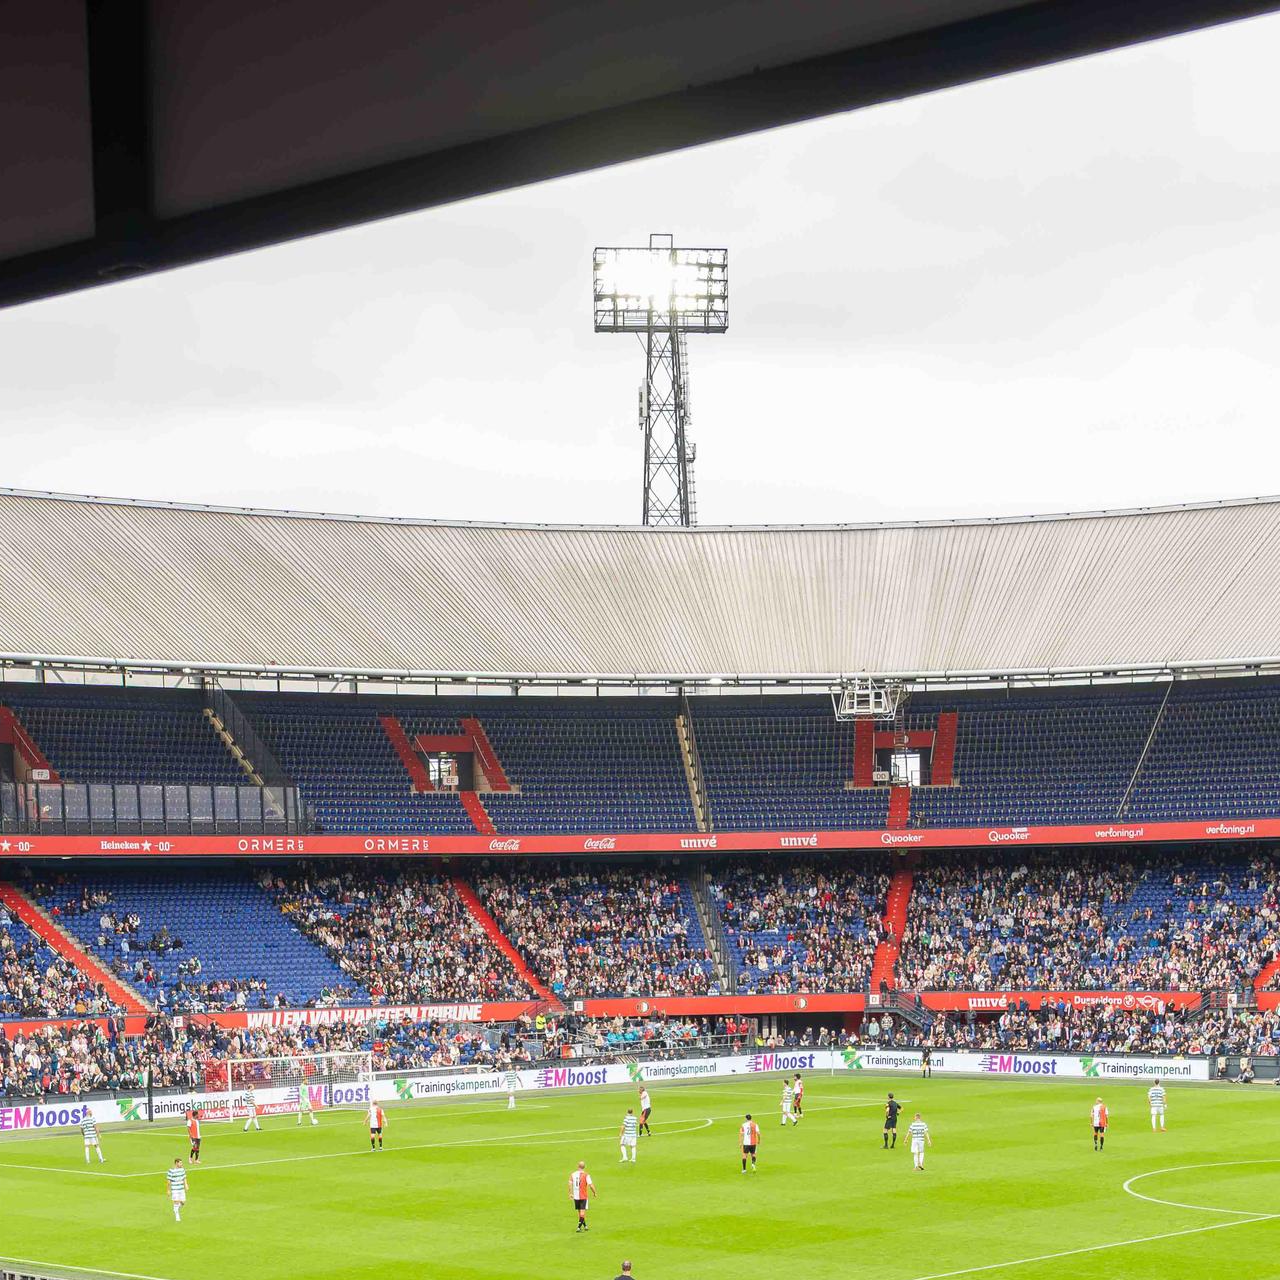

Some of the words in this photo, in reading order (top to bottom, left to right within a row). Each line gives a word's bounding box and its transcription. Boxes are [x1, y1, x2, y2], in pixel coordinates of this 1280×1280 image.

[680, 836, 716, 848] univé
[781, 834, 817, 846] univé
[881, 833, 923, 844] Quooker
[988, 832, 1029, 842] Quooker
[101, 841, 139, 849] Heineken
[239, 840, 294, 850] ORMER
[365, 839, 419, 850] ORMER
[968, 994, 1008, 1008] univé
[754, 1054, 815, 1072] EMboost
[866, 1055, 944, 1068] Trainingskamn.nl
[989, 1055, 1056, 1075] EMboost
[646, 1062, 717, 1078] Trainingskampen.nl
[1102, 1062, 1191, 1078] Trainingskampen.nl
[544, 1067, 608, 1087] EMboost
[414, 1077, 500, 1094] Trainingskampen.nl
